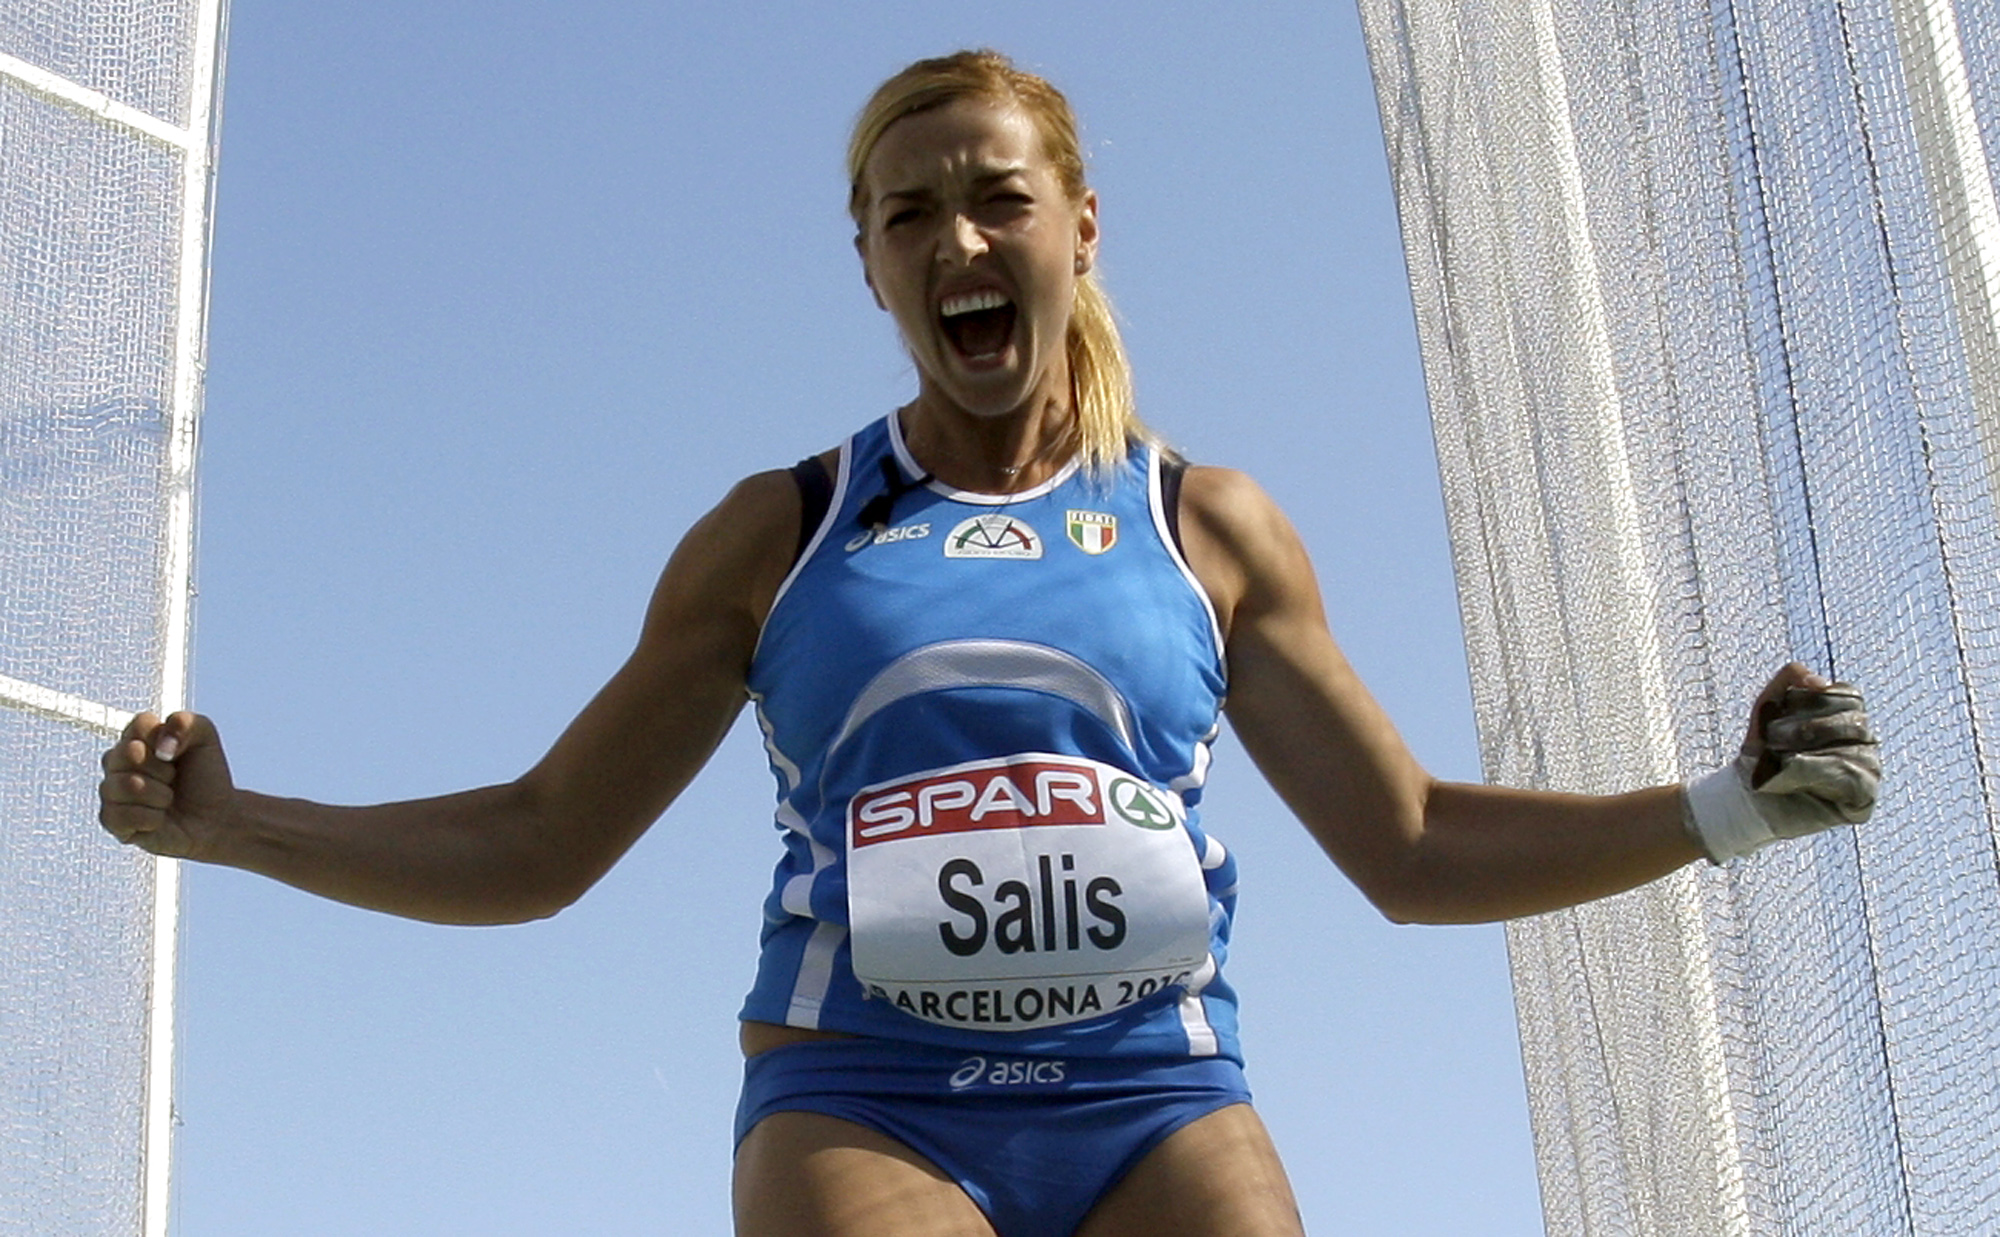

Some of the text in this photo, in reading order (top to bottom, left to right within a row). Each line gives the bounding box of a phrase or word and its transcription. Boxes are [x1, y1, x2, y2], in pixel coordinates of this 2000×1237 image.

[859, 770, 1097, 838] SPAR
[938, 854, 1126, 957] Salis
[988, 1061, 1065, 1084] asics
